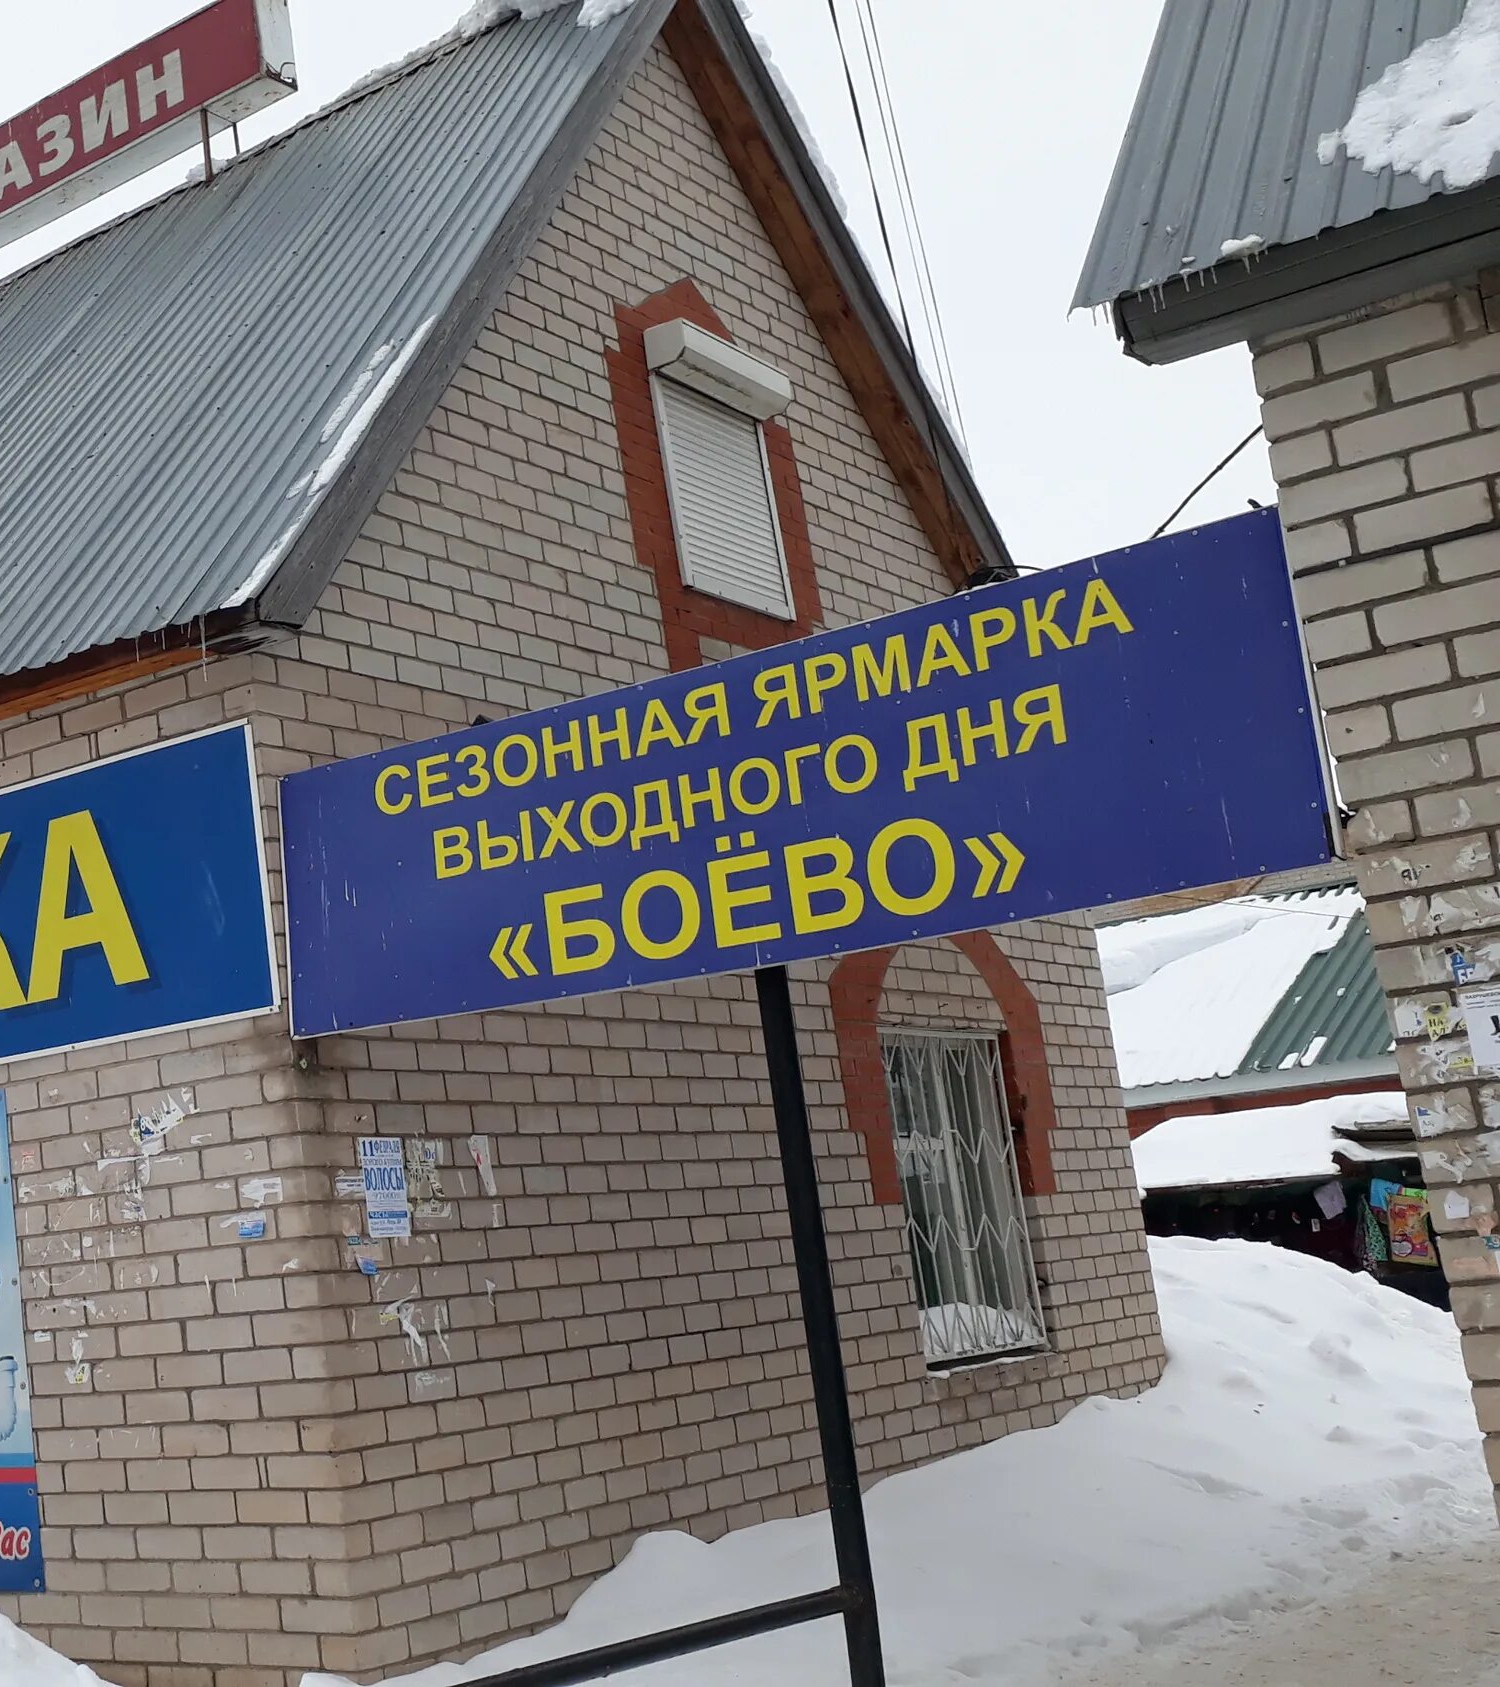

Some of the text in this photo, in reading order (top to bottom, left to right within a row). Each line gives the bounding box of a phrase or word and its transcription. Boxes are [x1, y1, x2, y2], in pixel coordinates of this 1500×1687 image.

[374, 578, 1135, 816] СЕЗОННАЯ ЯРМАРКА
[433, 684, 1068, 880] ВЫХОДНОГО ДНЯ
[488, 817, 1027, 980] «БОЁВО»
[364, 1167, 405, 1191] ВОЛОСЫ
